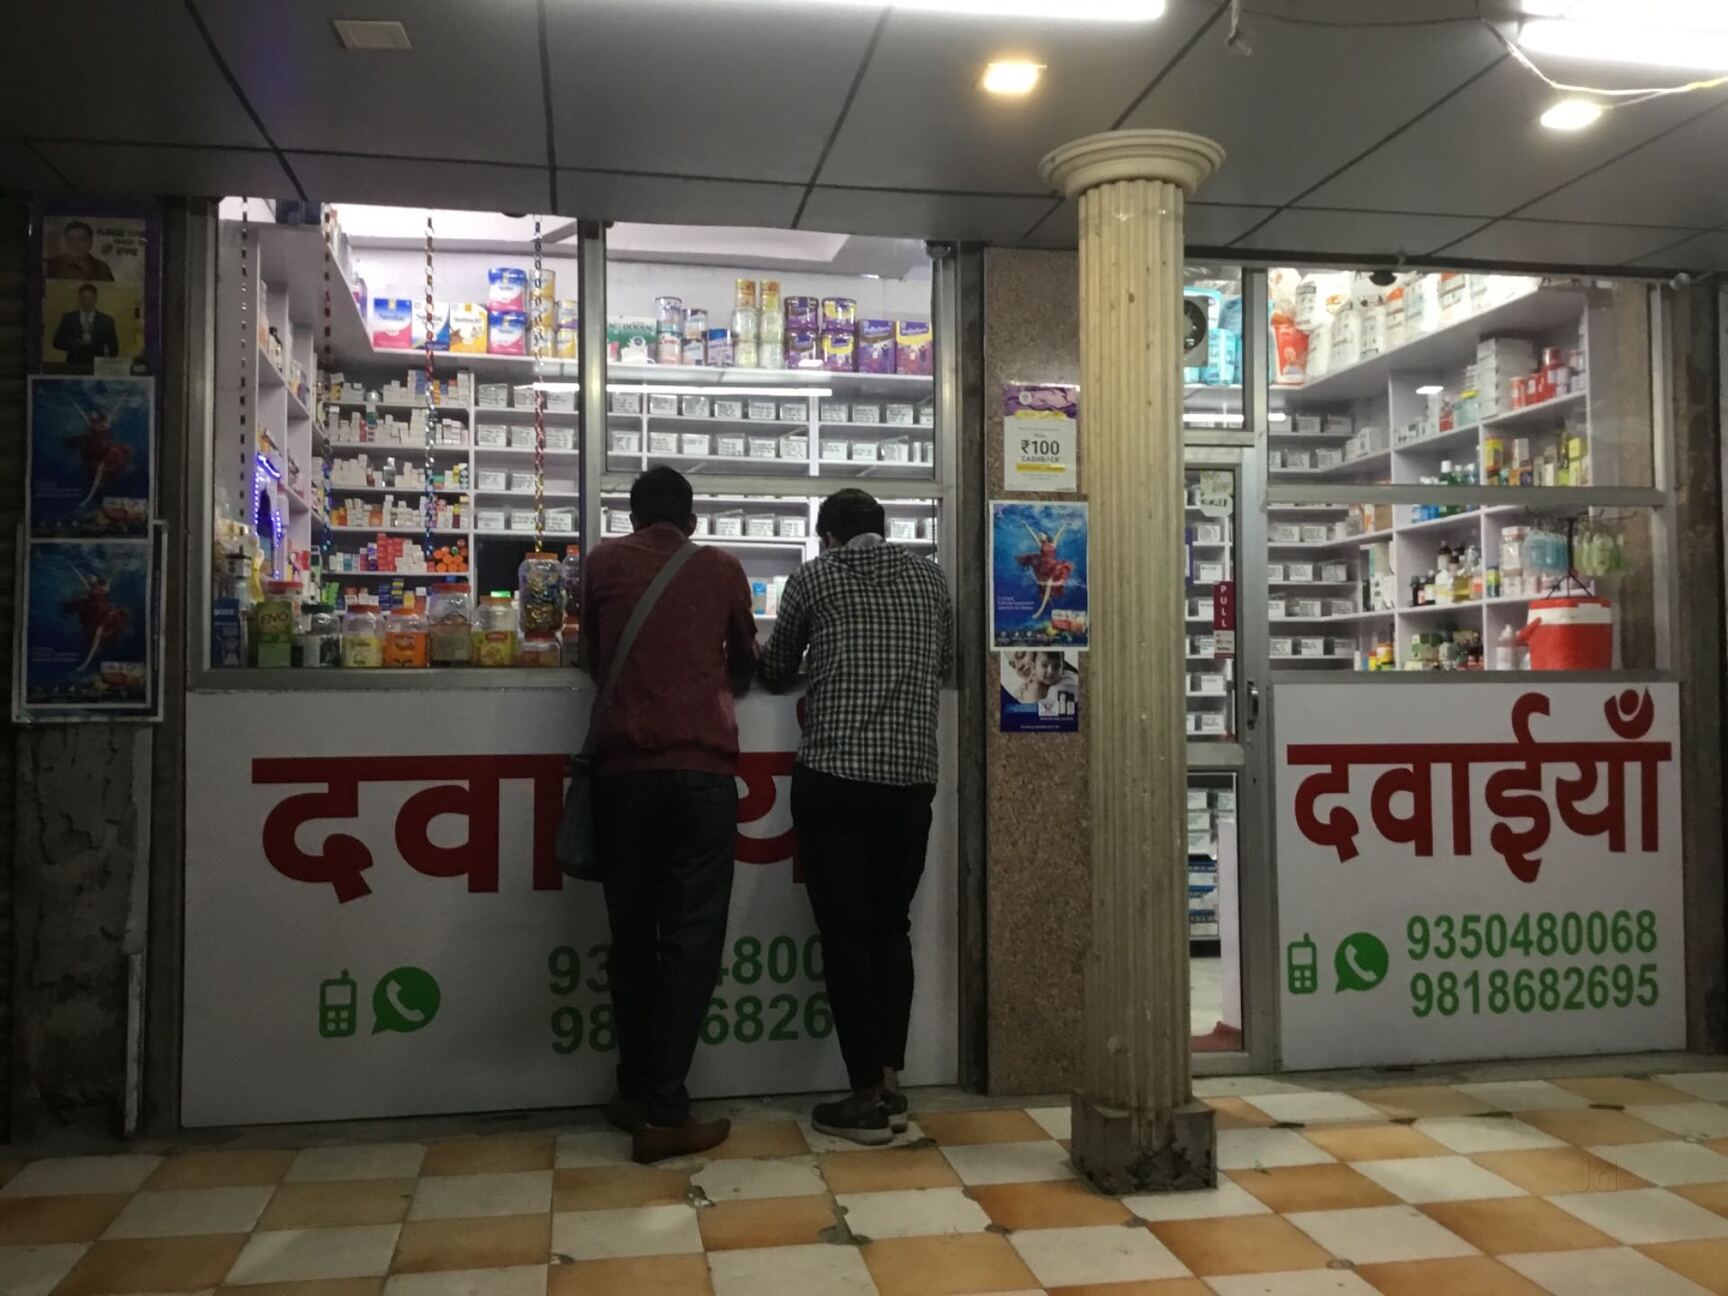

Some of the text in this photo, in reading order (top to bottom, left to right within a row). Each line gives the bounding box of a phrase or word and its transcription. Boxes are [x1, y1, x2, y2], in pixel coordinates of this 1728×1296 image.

[1020, 439, 1060, 455] ₹100
[260, 611, 289, 625] ENO
[1219, 584, 1228, 628] PULL
[1406, 909, 1658, 961] 9350480068
[1409, 964, 1660, 1018] 9818682695
[550, 992, 834, 1055] 986826
